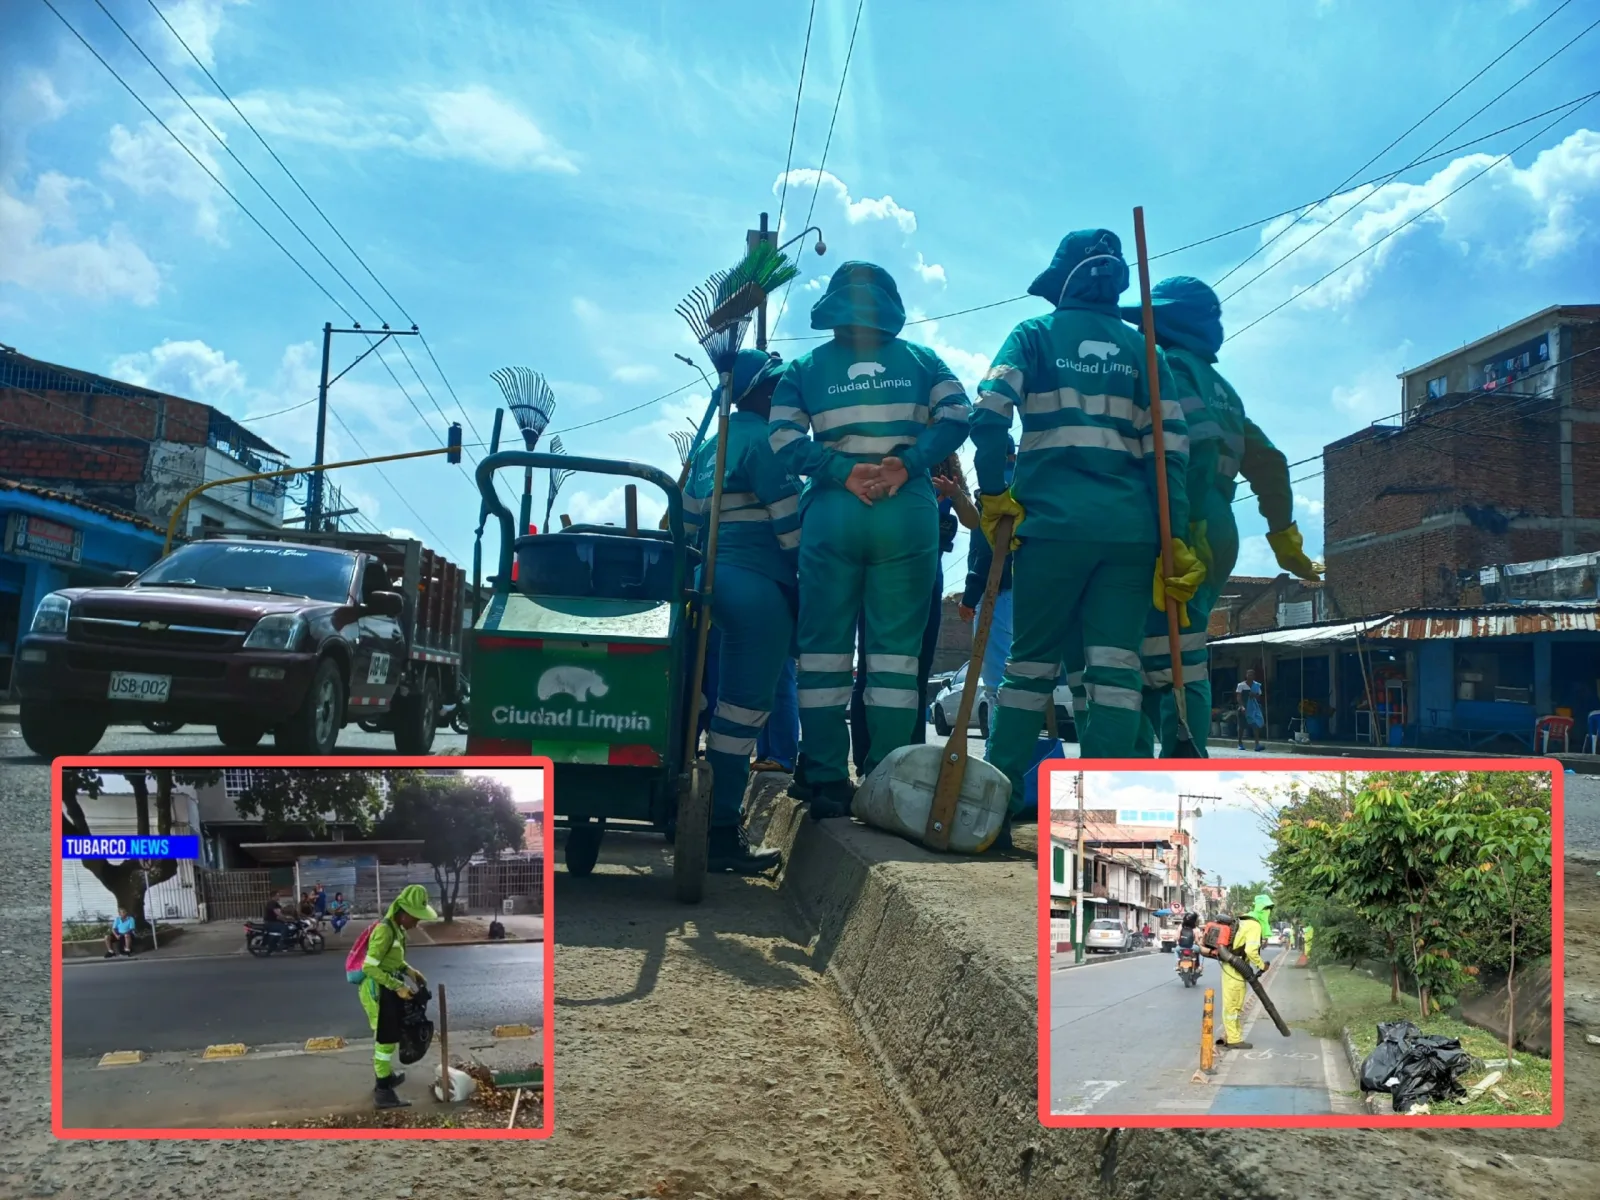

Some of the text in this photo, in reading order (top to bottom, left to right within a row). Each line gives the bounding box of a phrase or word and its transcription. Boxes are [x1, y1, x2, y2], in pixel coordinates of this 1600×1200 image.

[1103, 362, 1139, 379] Limpa
[828, 377, 912, 394] Ciudad Limpia
[491, 705, 651, 733] Ciudad Limpia
